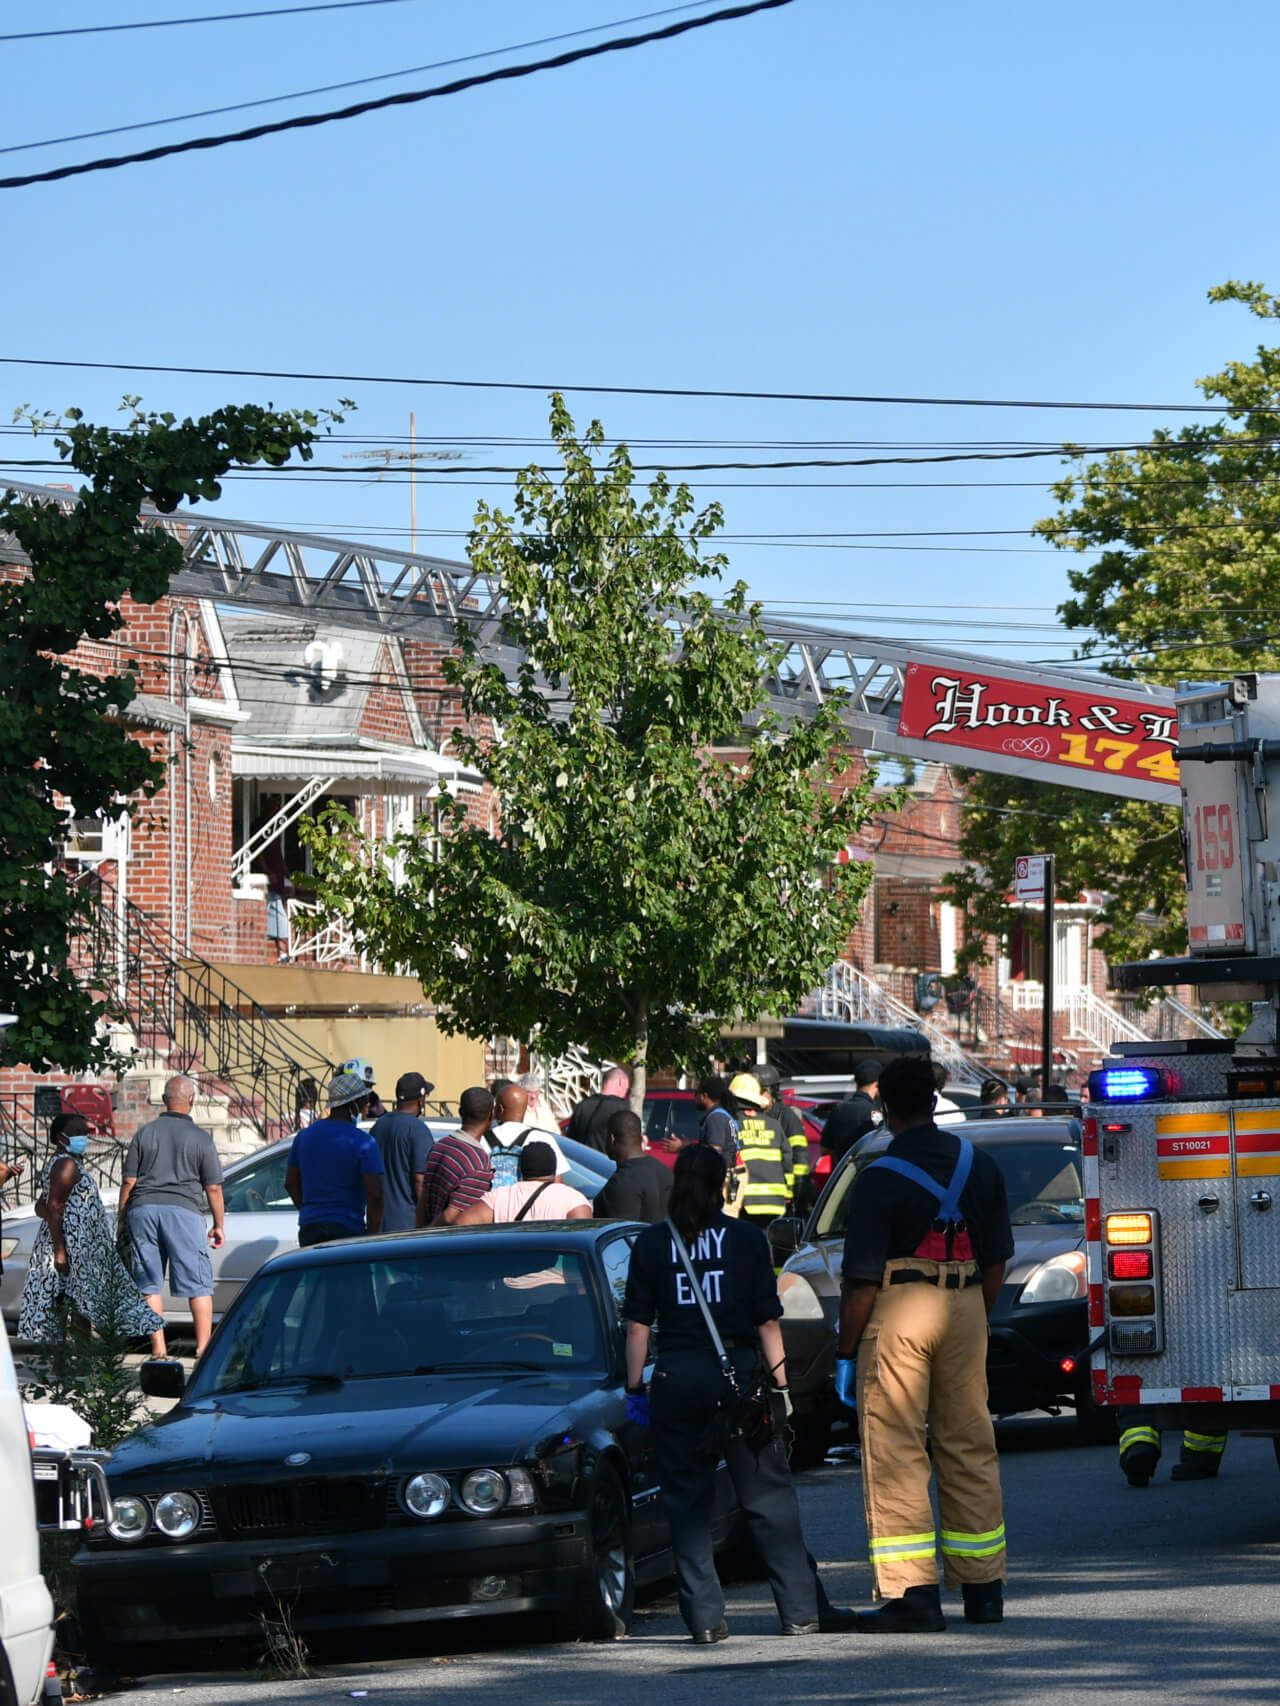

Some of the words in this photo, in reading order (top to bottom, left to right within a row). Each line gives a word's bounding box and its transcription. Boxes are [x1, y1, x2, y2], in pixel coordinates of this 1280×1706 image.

[925, 676, 1072, 739] Hook
[1079, 705, 1136, 735] &
[1058, 732, 1180, 781] 174
[1194, 803, 1234, 871] 159
[743, 1119, 767, 1130] FDNY
[1172, 1140, 1211, 1151] ST10021
[675, 1270, 725, 1305] EMT
